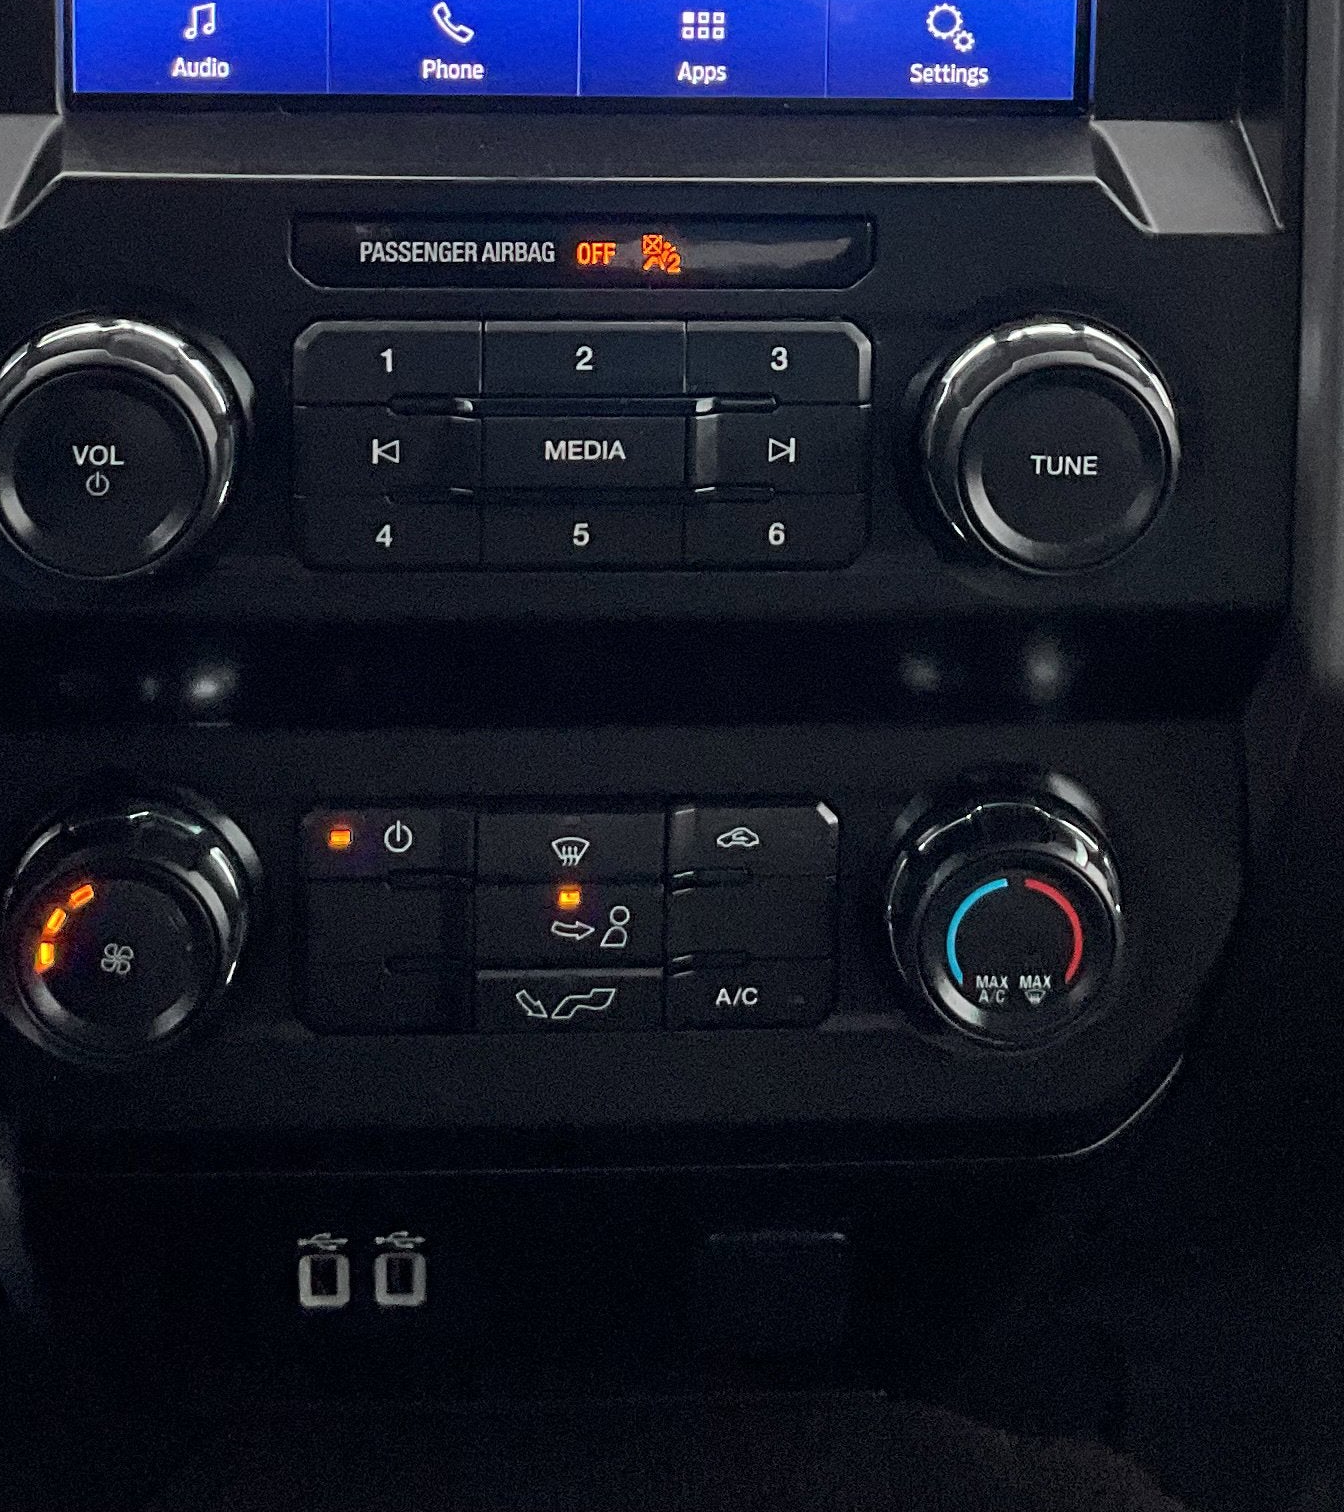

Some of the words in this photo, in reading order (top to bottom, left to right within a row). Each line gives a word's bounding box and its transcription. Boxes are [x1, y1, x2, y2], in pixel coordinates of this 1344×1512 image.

[171, 57, 230, 77] Audio
[421, 59, 484, 79] Phone
[677, 61, 727, 84] Apps
[909, 62, 989, 87] Settings
[359, 241, 478, 264] PASSENGER
[481, 241, 556, 264] AIRBAG
[576, 241, 616, 266] OFF
[381, 349, 392, 372] 1
[576, 346, 592, 370] 2
[771, 347, 787, 370] 3
[73, 445, 124, 465] VOL
[545, 441, 626, 460] MEDIA
[1031, 455, 1097, 475] TUNE
[376, 525, 392, 547] 4
[573, 523, 589, 546] 5
[769, 523, 784, 545] 6
[976, 974, 1009, 989] MAX
[1019, 974, 1052, 989] MAX
[716, 988, 757, 1005] A/C
[978, 989, 1006, 1004] A/C
